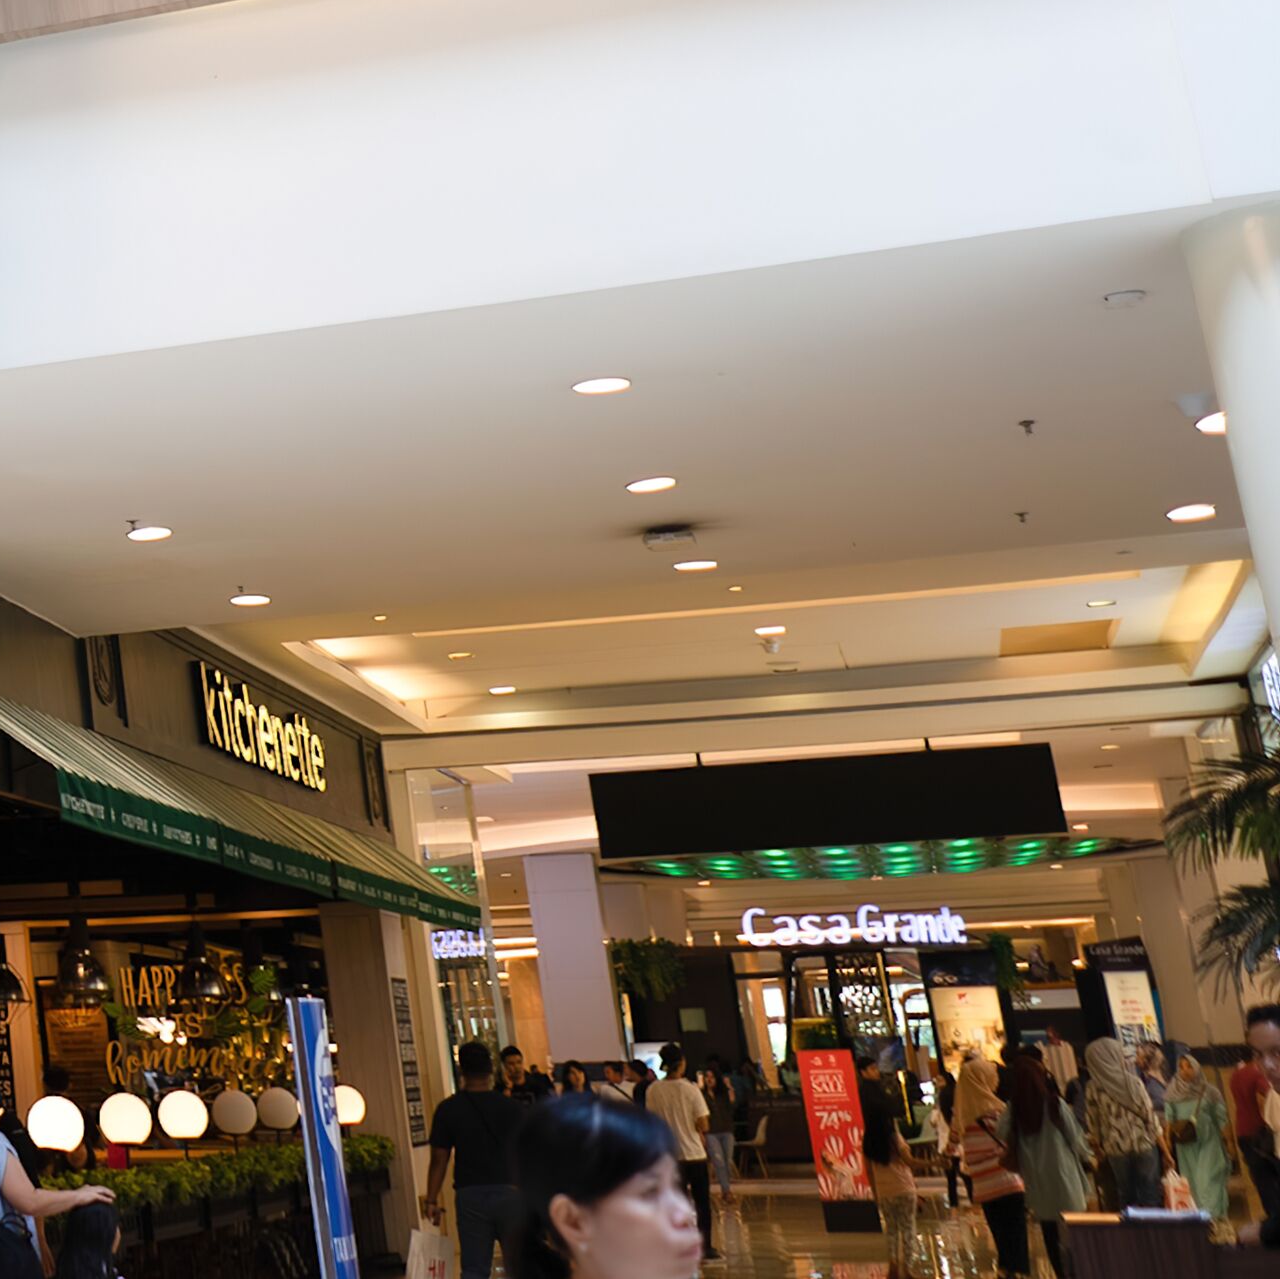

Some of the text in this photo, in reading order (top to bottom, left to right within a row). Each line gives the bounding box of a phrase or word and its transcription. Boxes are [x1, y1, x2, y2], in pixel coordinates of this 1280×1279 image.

[200, 661, 327, 792] kitchenette
[741, 904, 968, 947] Casa Grande
[811, 1081, 847, 1094] SALE
